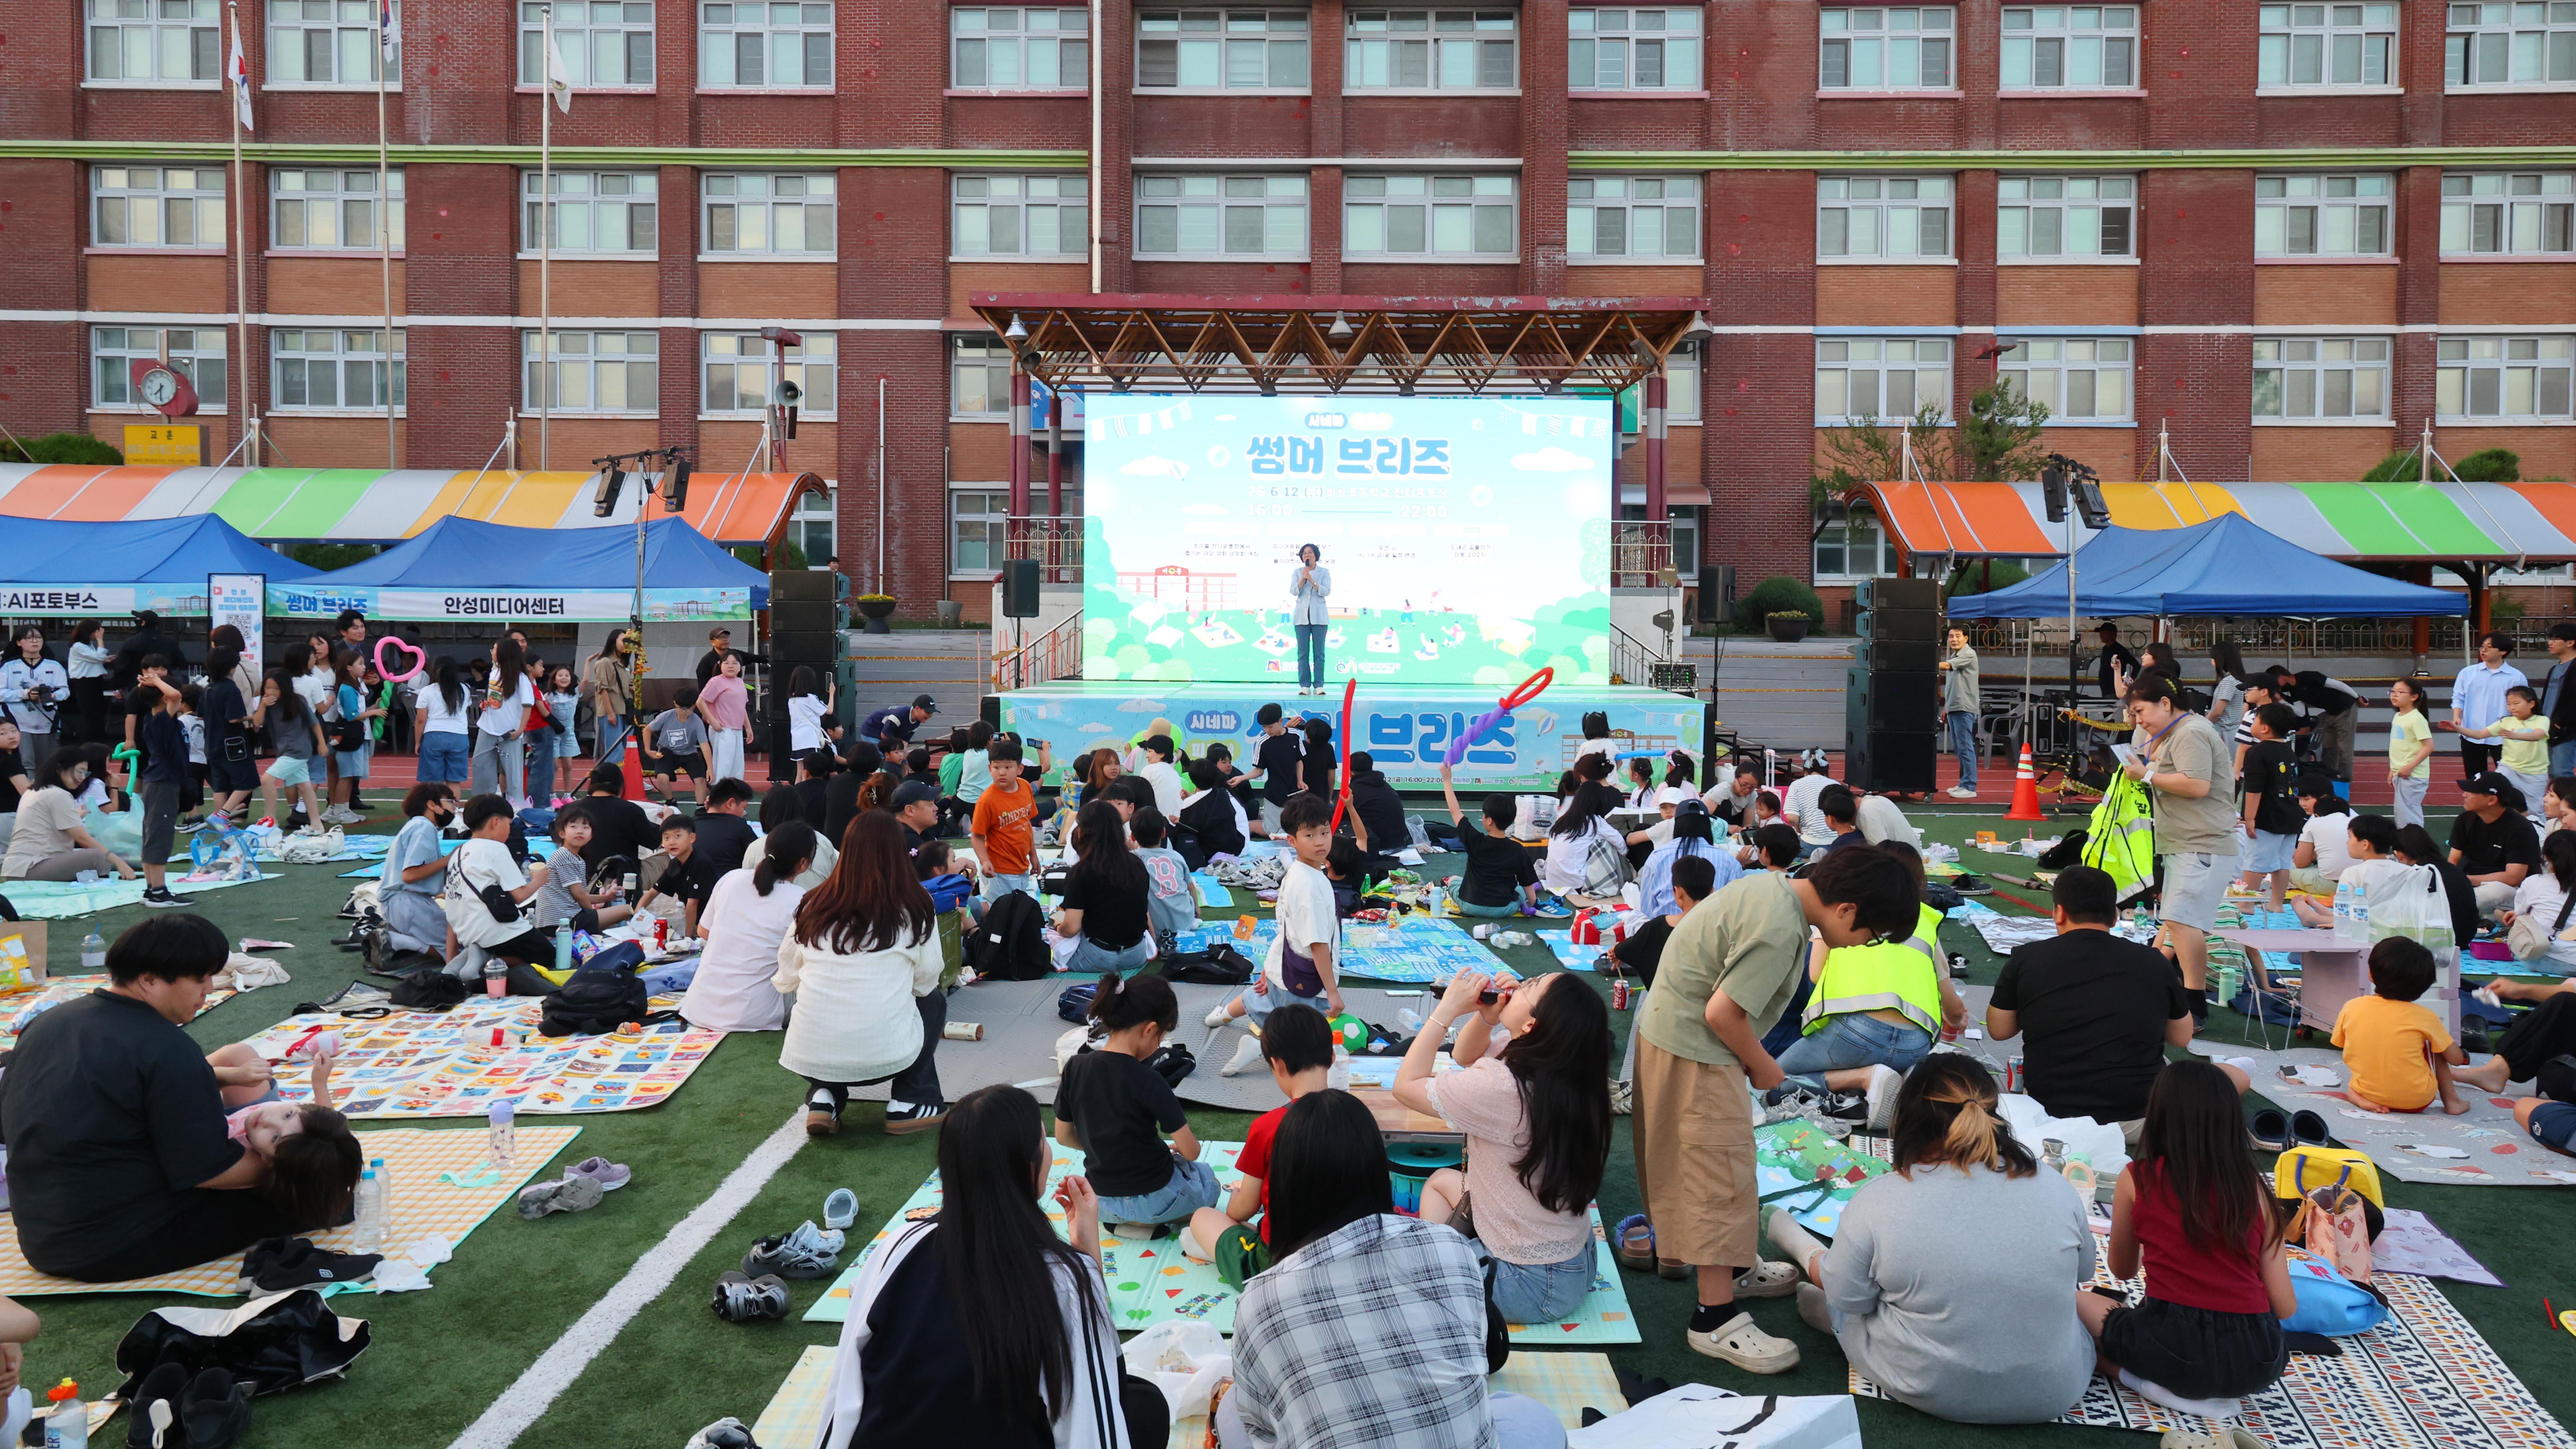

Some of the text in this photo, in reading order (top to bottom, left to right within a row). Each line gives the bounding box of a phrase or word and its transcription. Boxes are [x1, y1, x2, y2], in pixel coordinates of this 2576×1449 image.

[1246, 435, 1450, 475] 썸머 브리즈
[1248, 504, 1448, 518] 16:00 22:00
[0, 592, 99, 610] :AI포토부스
[285, 595, 368, 614] 썸머 브리즈
[444, 596, 564, 615] 안성미디어센터
[1190, 714, 1236, 730] 시네마
[1366, 711, 1517, 764] 브리즈
